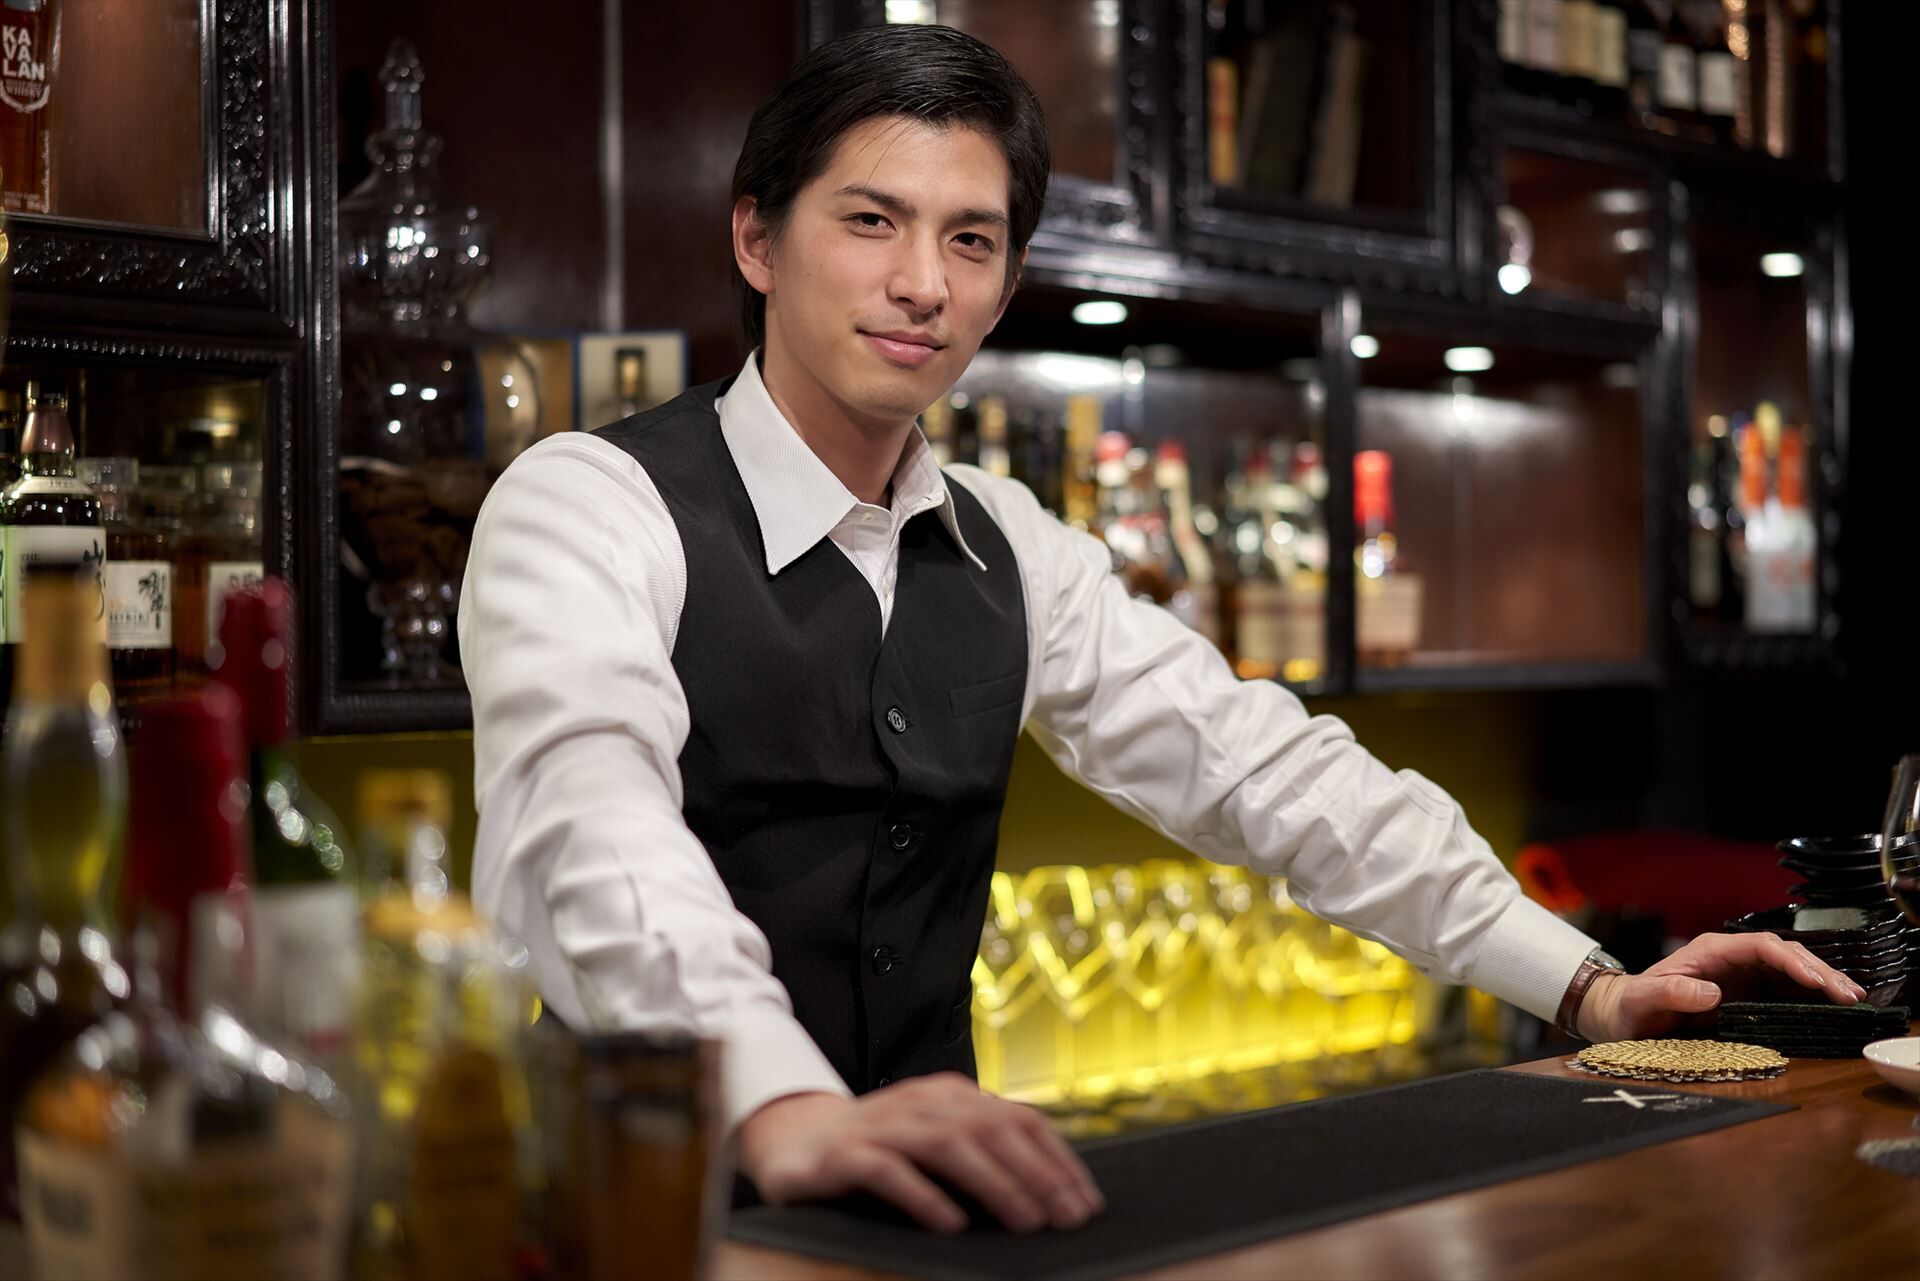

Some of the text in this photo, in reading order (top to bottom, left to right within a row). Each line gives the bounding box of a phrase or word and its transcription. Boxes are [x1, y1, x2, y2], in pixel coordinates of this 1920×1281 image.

[3, 25, 31, 46] KA
[3, 43, 31, 62] VA
[3, 58, 45, 81] LAN
